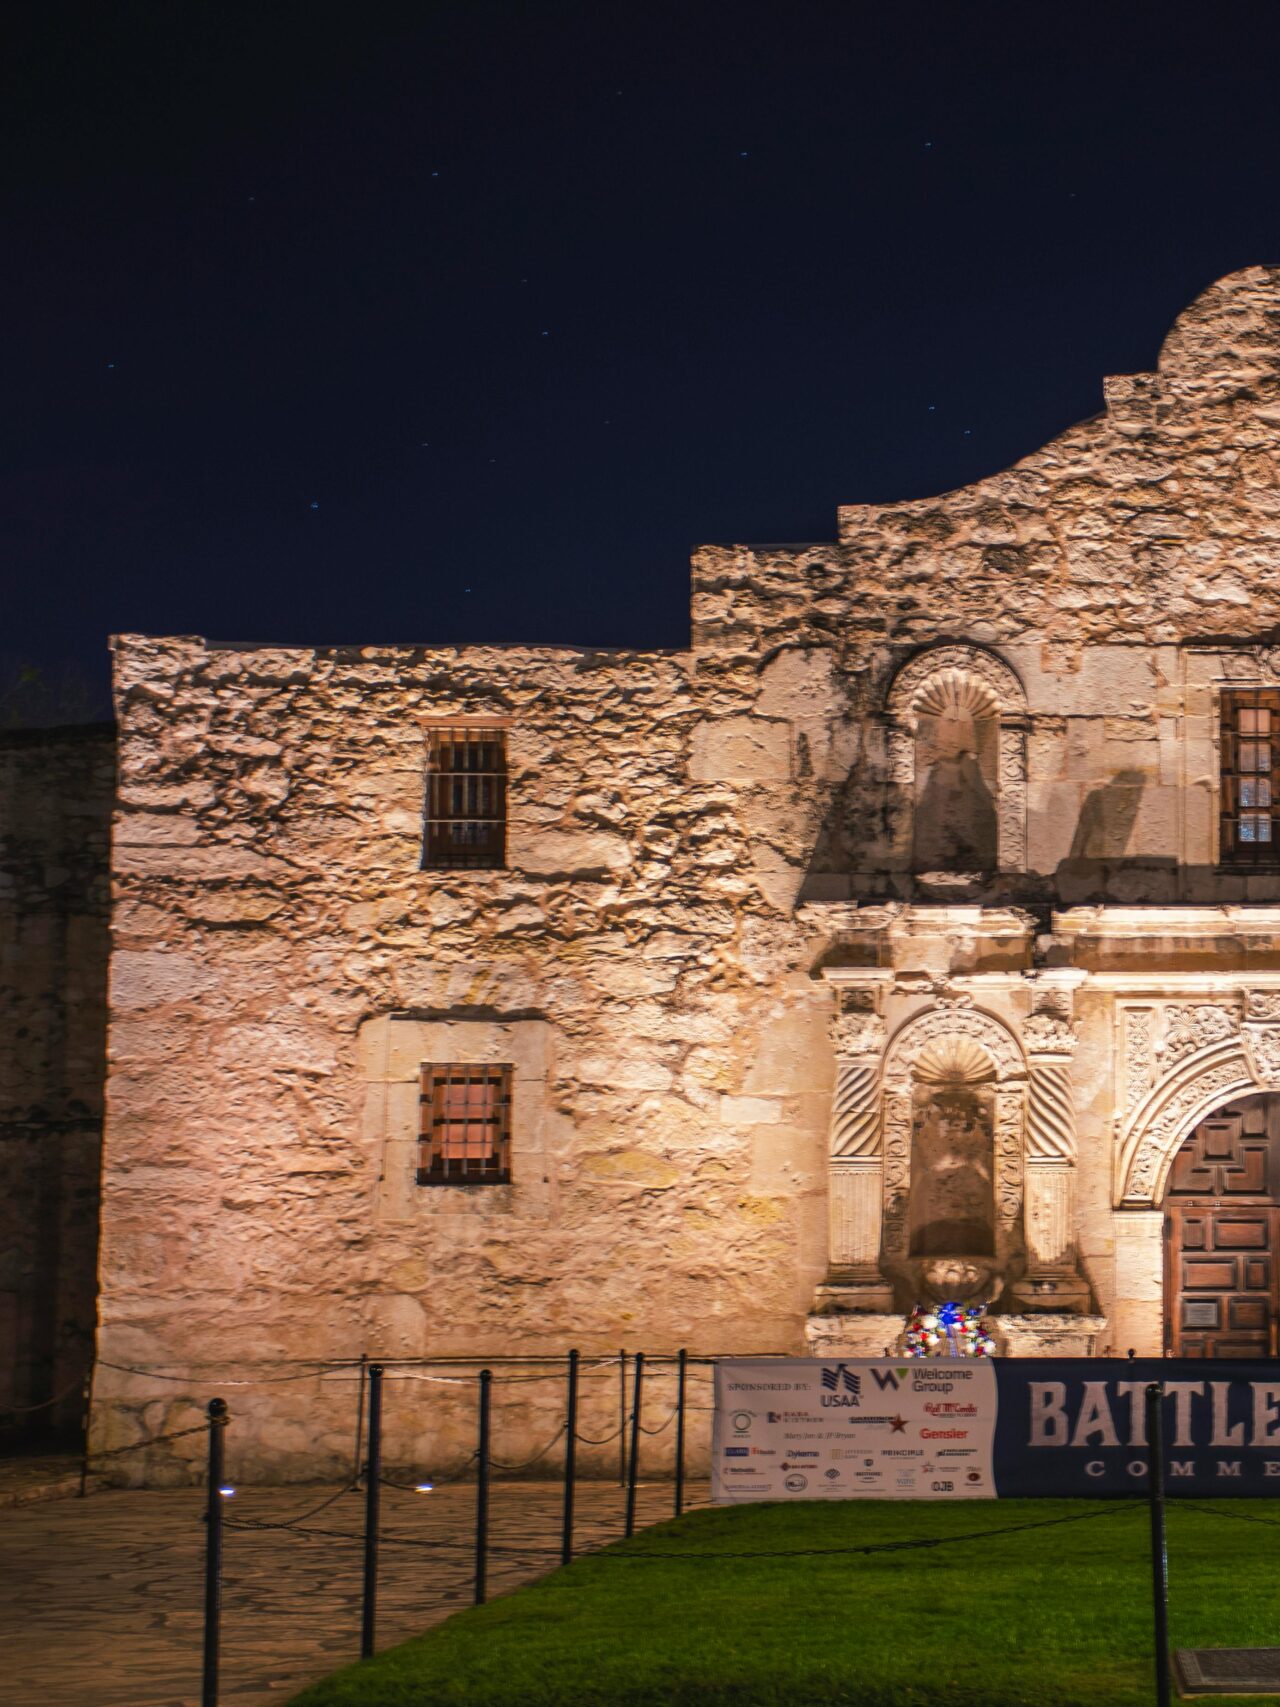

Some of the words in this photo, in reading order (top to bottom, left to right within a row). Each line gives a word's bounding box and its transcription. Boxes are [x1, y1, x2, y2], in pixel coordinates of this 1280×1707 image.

[911, 1368, 973, 1380] Welcome
[727, 1383, 793, 1391] SPONSORED
[911, 1381, 954, 1396] Group
[820, 1395, 860, 1408] USAA
[919, 1428, 969, 1439] Gensler
[930, 1481, 954, 1492] OJB
